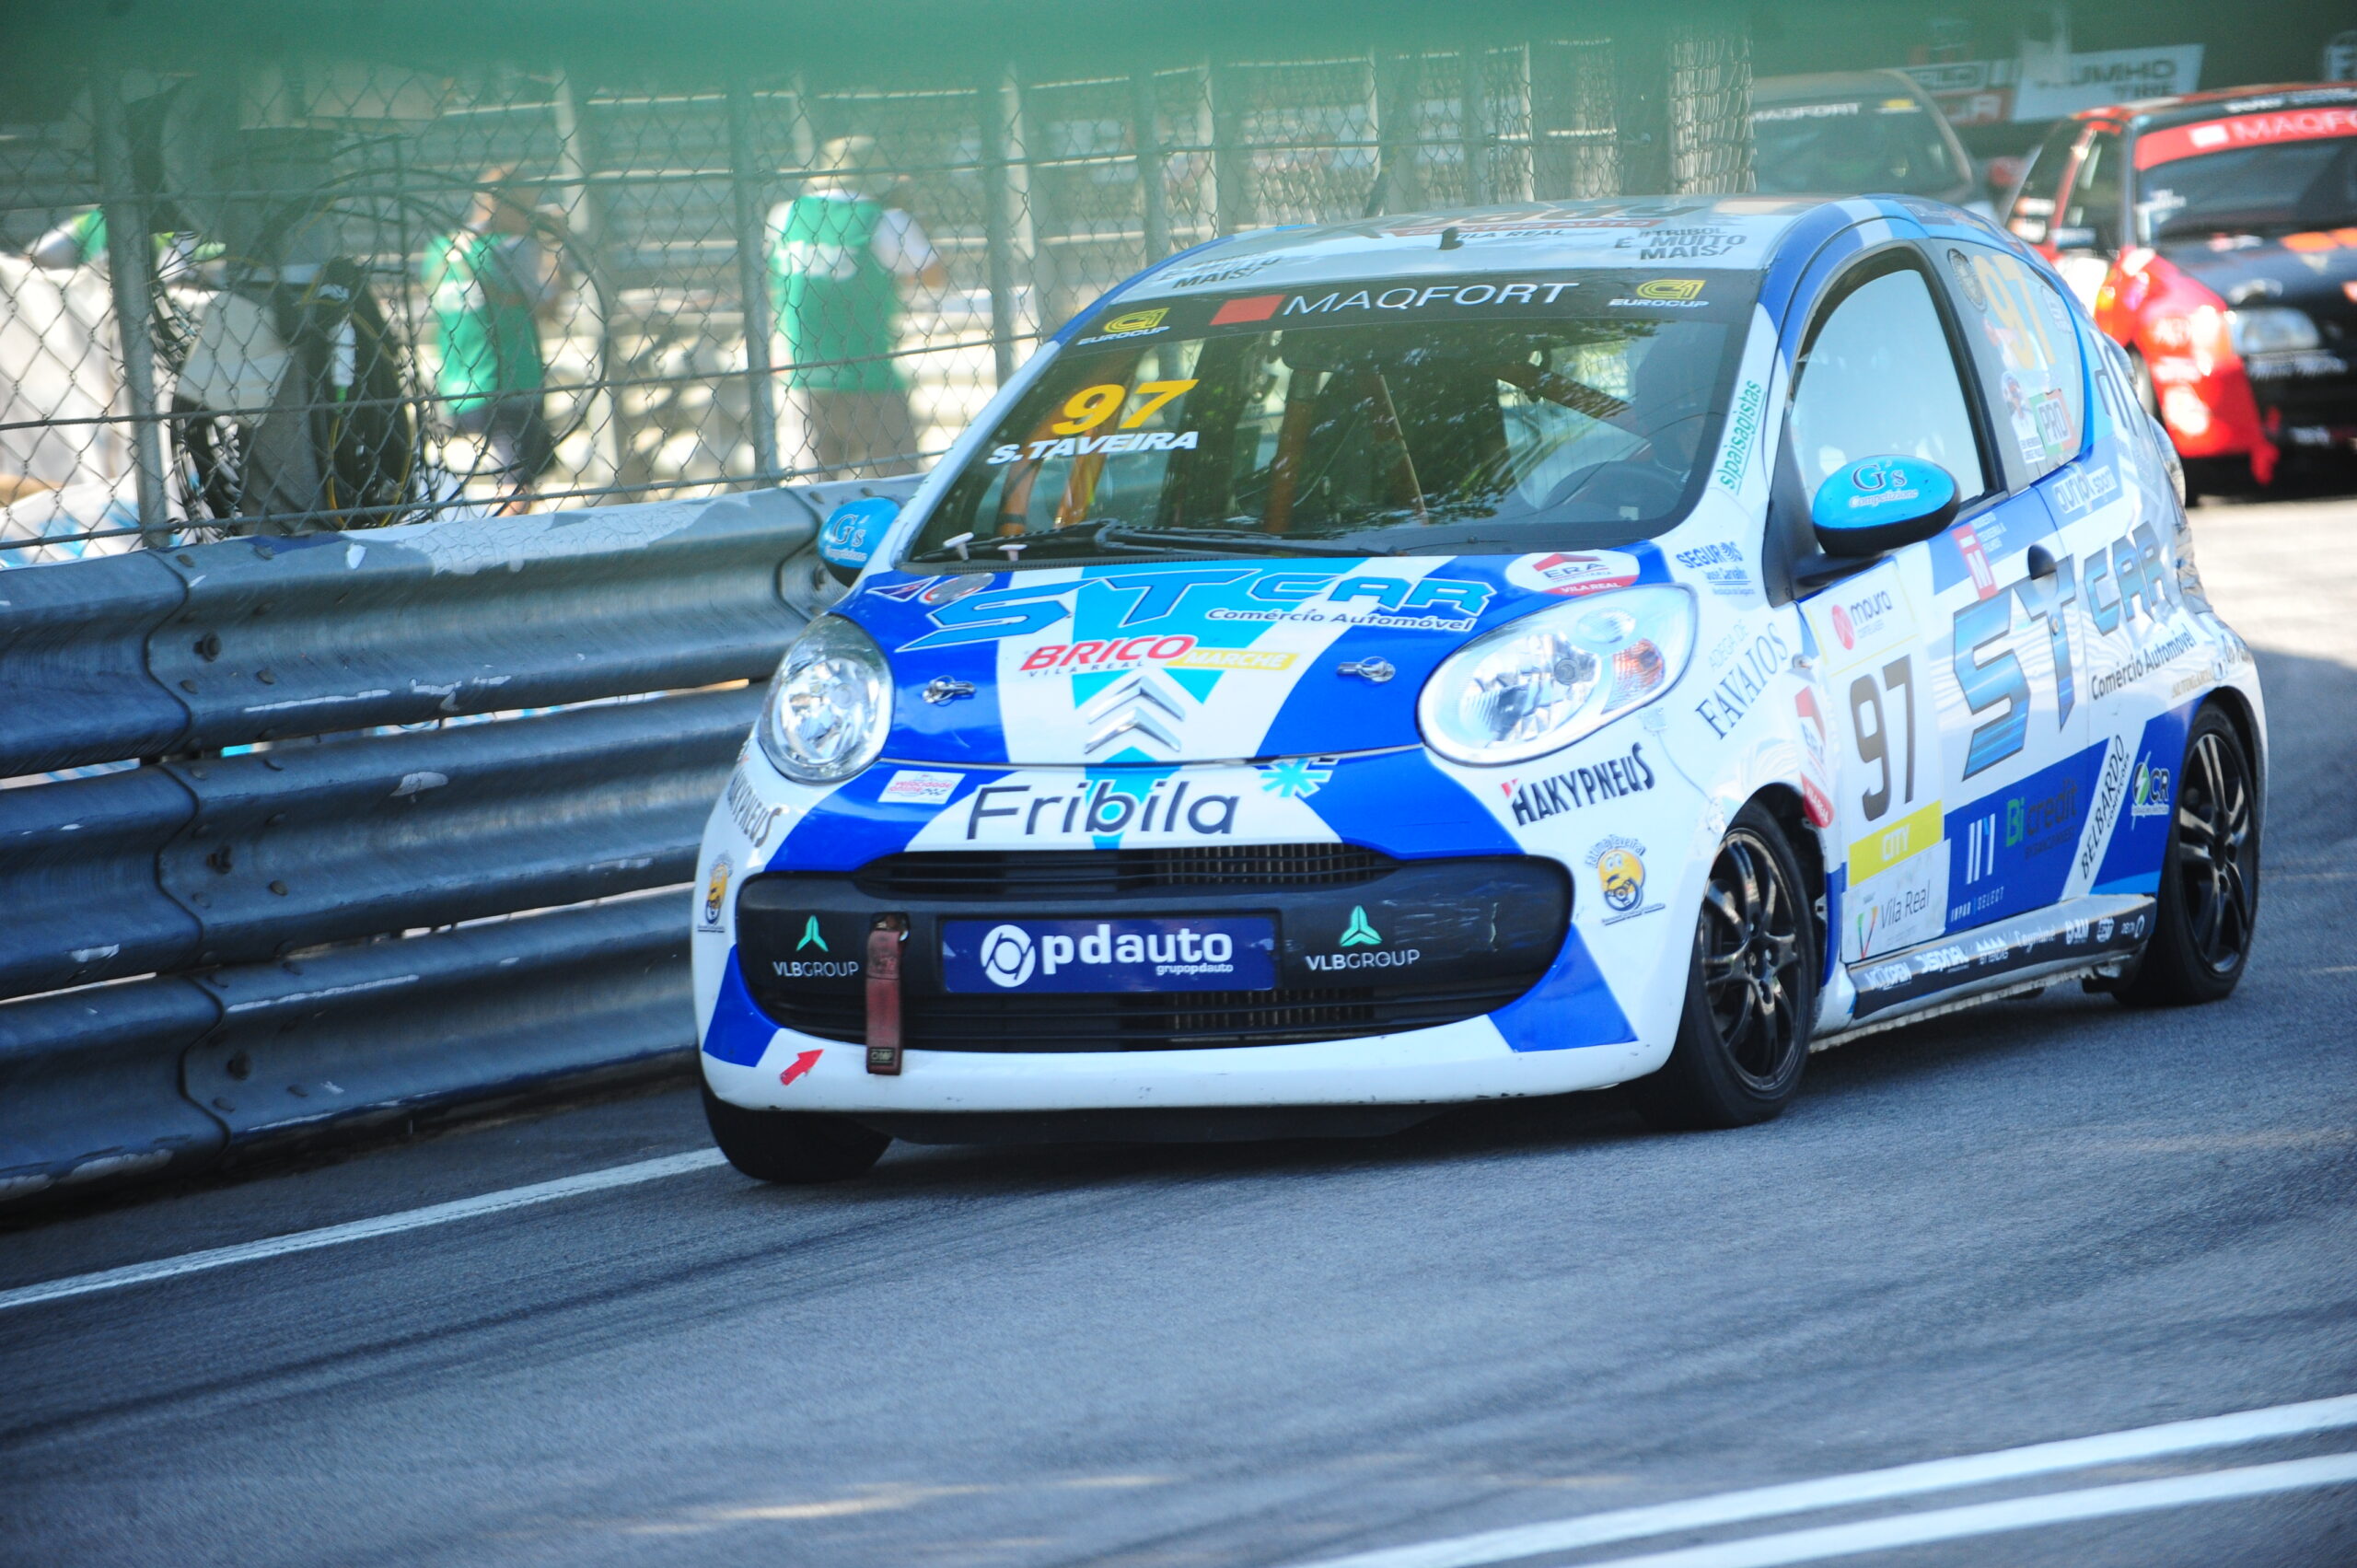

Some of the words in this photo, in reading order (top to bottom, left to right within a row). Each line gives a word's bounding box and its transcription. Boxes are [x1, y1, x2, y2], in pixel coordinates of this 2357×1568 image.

[1508, 228, 1566, 238] REAL
[1561, 219, 1652, 229] AUTO
[1640, 245, 1733, 261] MAIS!
[1650, 235, 1747, 248] MUITO
[1283, 282, 1581, 317] MAQFORT
[1608, 297, 1711, 309] EUROCUP
[1076, 326, 1170, 346] EUROCUP
[1051, 378, 1200, 436] 97
[1543, 563, 1607, 578] ERA
[1562, 585, 1588, 594] VILA
[1590, 582, 1622, 591] REAL
[1205, 608, 1326, 623] Comércio
[1329, 611, 1476, 633] Automóvel
[1018, 634, 1198, 671] BRICO
[2091, 653, 2143, 702] Comércio
[2145, 622, 2198, 679] Automóvel
[1028, 666, 1078, 678] VILA
[1091, 660, 1144, 672] REAL
[1694, 621, 1788, 740] FAVAIOS
[1849, 653, 1917, 822] 97
[1511, 741, 1655, 827] HAKYPNEUS
[967, 781, 1240, 841] Fribila
[2081, 734, 2125, 880] BELBARDO
[1881, 823, 1911, 863] CITY
[1881, 895, 1902, 929] Vila
[1905, 878, 1931, 919] Real
[1042, 923, 1234, 976] pdauto
[1304, 948, 1421, 972] VLBGROUP
[772, 959, 860, 979] VLBGROUP
[1155, 962, 1235, 977] grupopdauto
